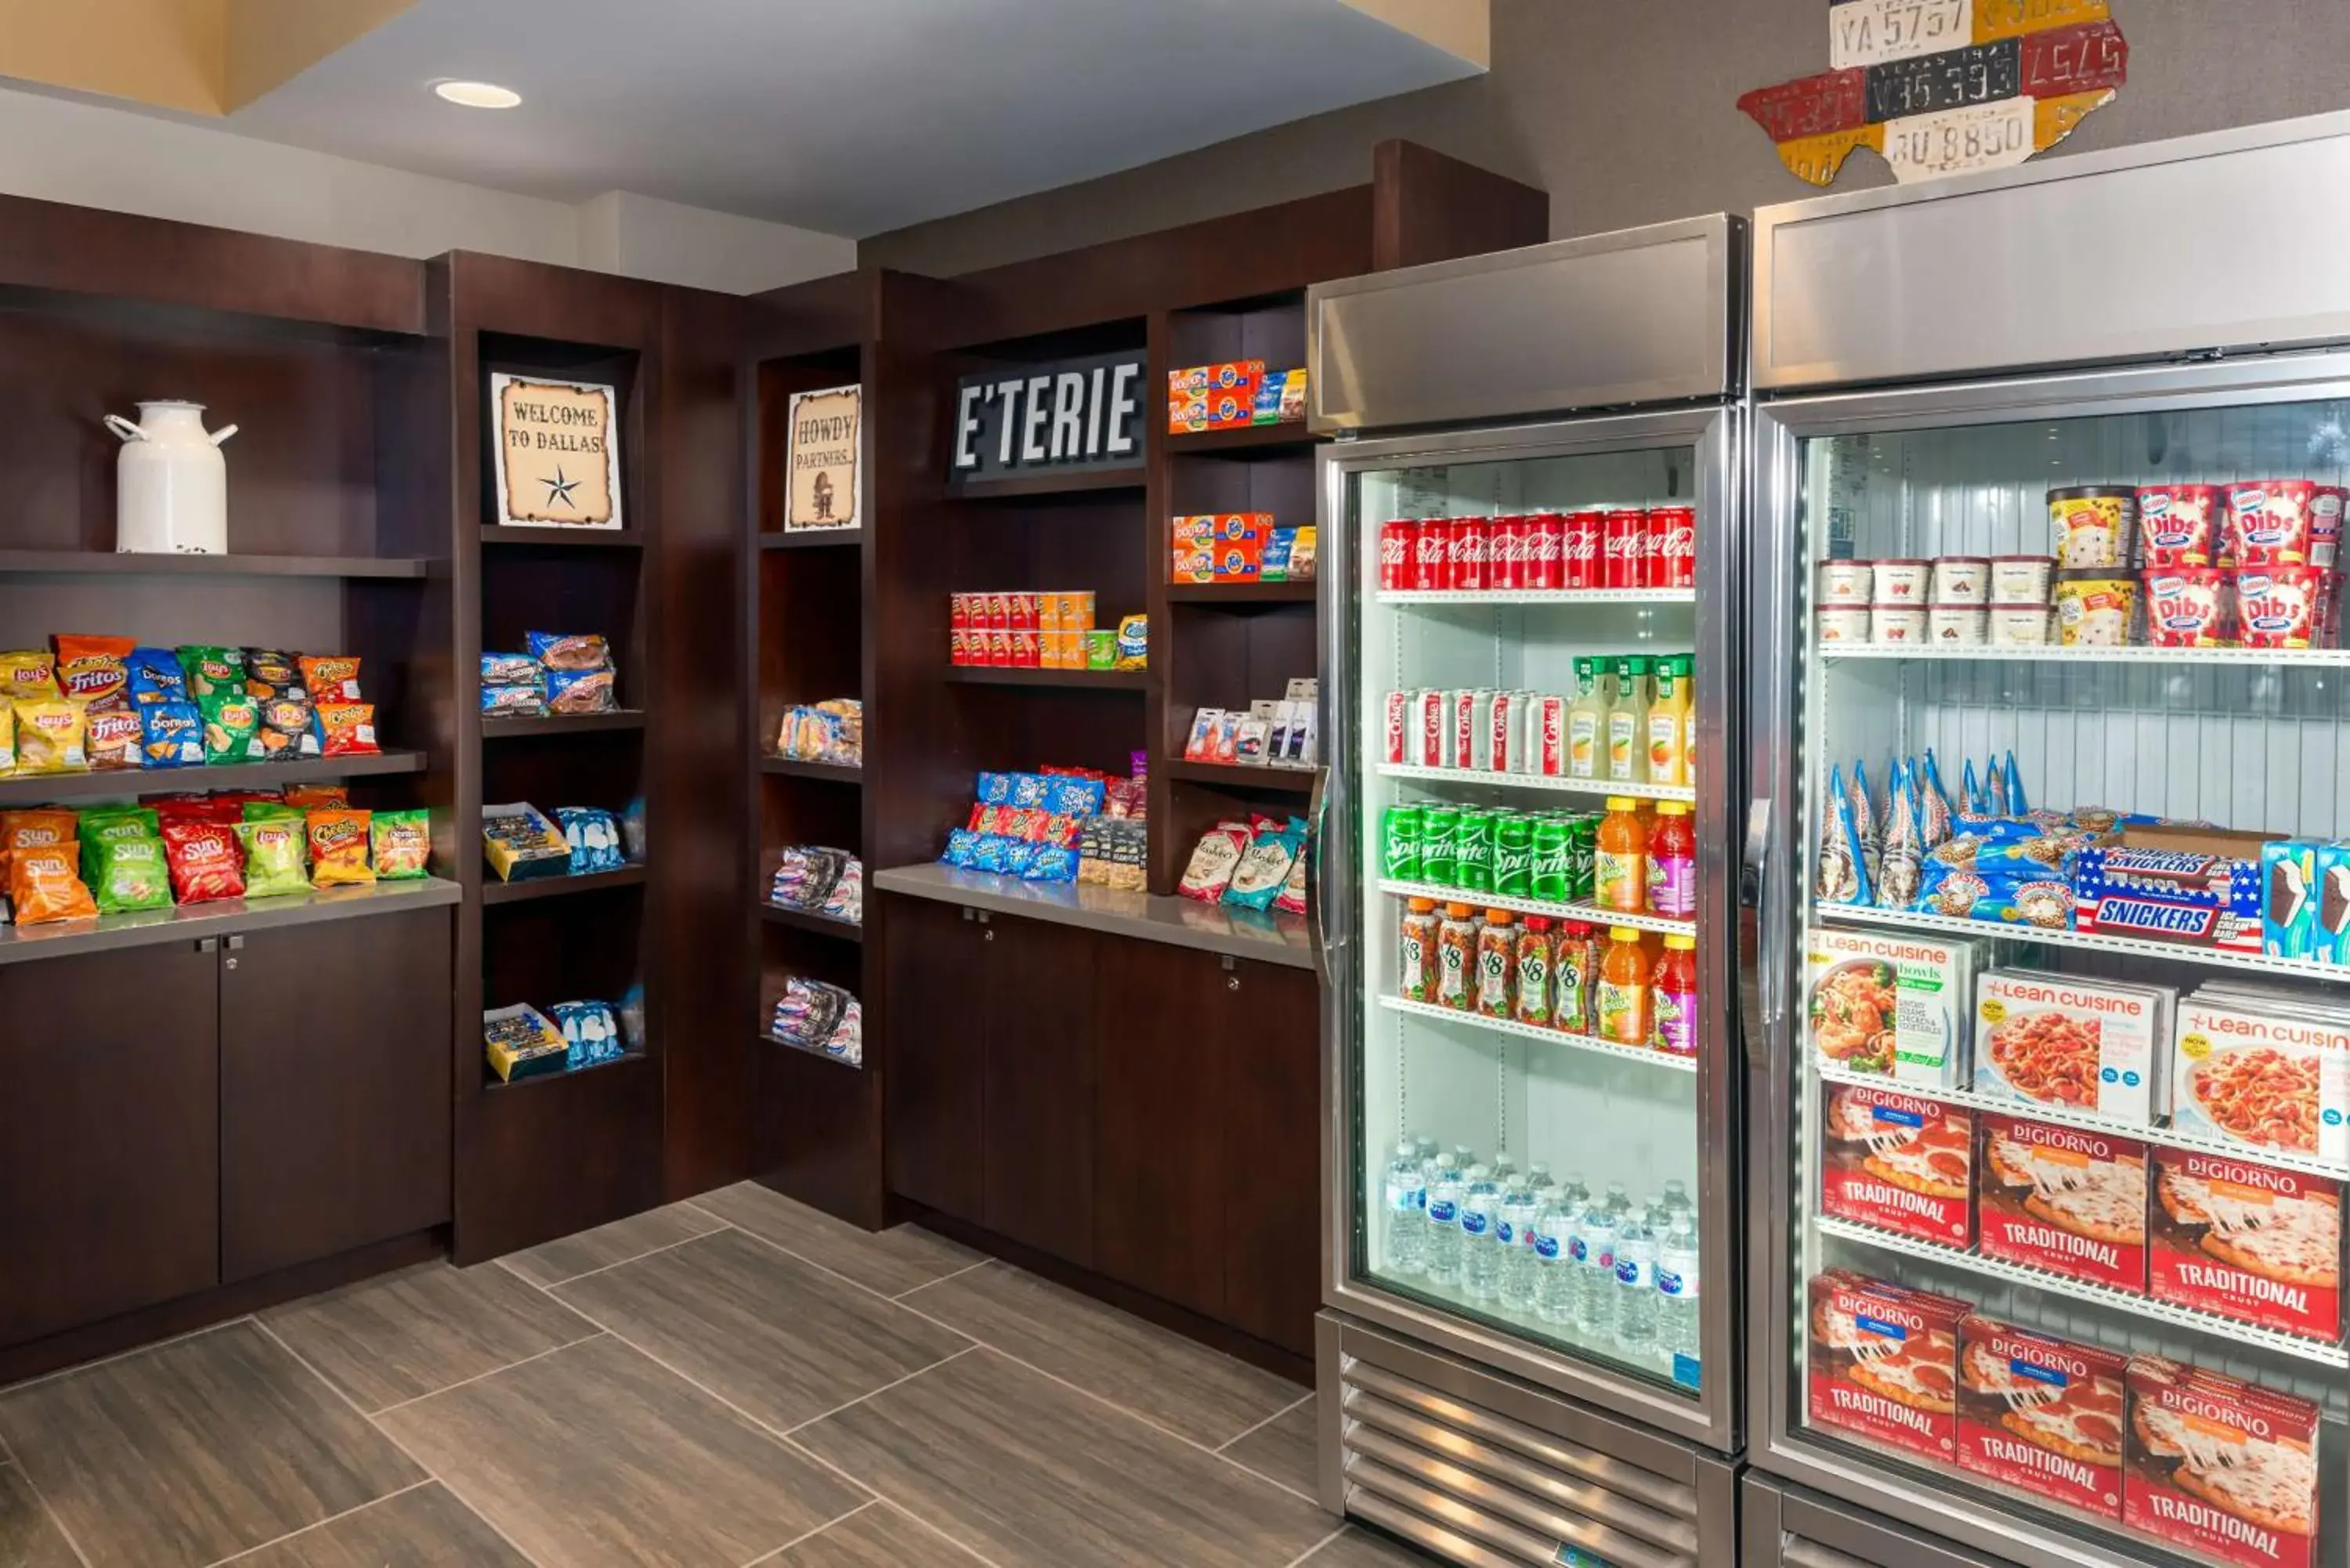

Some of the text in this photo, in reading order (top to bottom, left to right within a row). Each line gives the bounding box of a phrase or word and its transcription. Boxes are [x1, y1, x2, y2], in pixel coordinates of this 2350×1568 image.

[514, 402, 598, 427] WELCOME
[956, 363, 1138, 467] E'TERIE
[509, 430, 530, 447] TO
[799, 414, 854, 444] HOWDY
[2148, 514, 2198, 533] Dibs
[2241, 511, 2294, 533] Dibs
[2158, 598, 2210, 618] Dibs
[2247, 596, 2300, 619] Dibs
[67, 670, 122, 691] Fritos
[1390, 702, 1404, 735] Coke
[1426, 703, 1440, 739] Coke
[1459, 706, 1472, 739] Coke
[1494, 707, 1506, 742] Coke
[1545, 708, 1560, 745] Coke
[16, 828, 57, 847] Sun
[114, 842, 154, 861] Sun
[183, 838, 223, 860] Sun
[26, 858, 65, 876] Sun
[2099, 900, 2209, 934] SNICKERS
[1827, 934, 1872, 953] Lean
[1521, 955, 1543, 982] V8
[1898, 963, 1942, 979] bowls
[2003, 982, 2055, 1004] Lean
[2207, 1016, 2350, 1051] Lean cuisin
[1843, 1180, 1946, 1223] TRADITIONAL
[2003, 1223, 2119, 1270] TRADITIONAL
[2175, 1263, 2309, 1315] TRADITIONAL
[1831, 1388, 1934, 1437] TRADITIONAL
[1980, 1437, 2097, 1492] TRADITIONAL
[2149, 1494, 2280, 1560] TRADITIONAL
